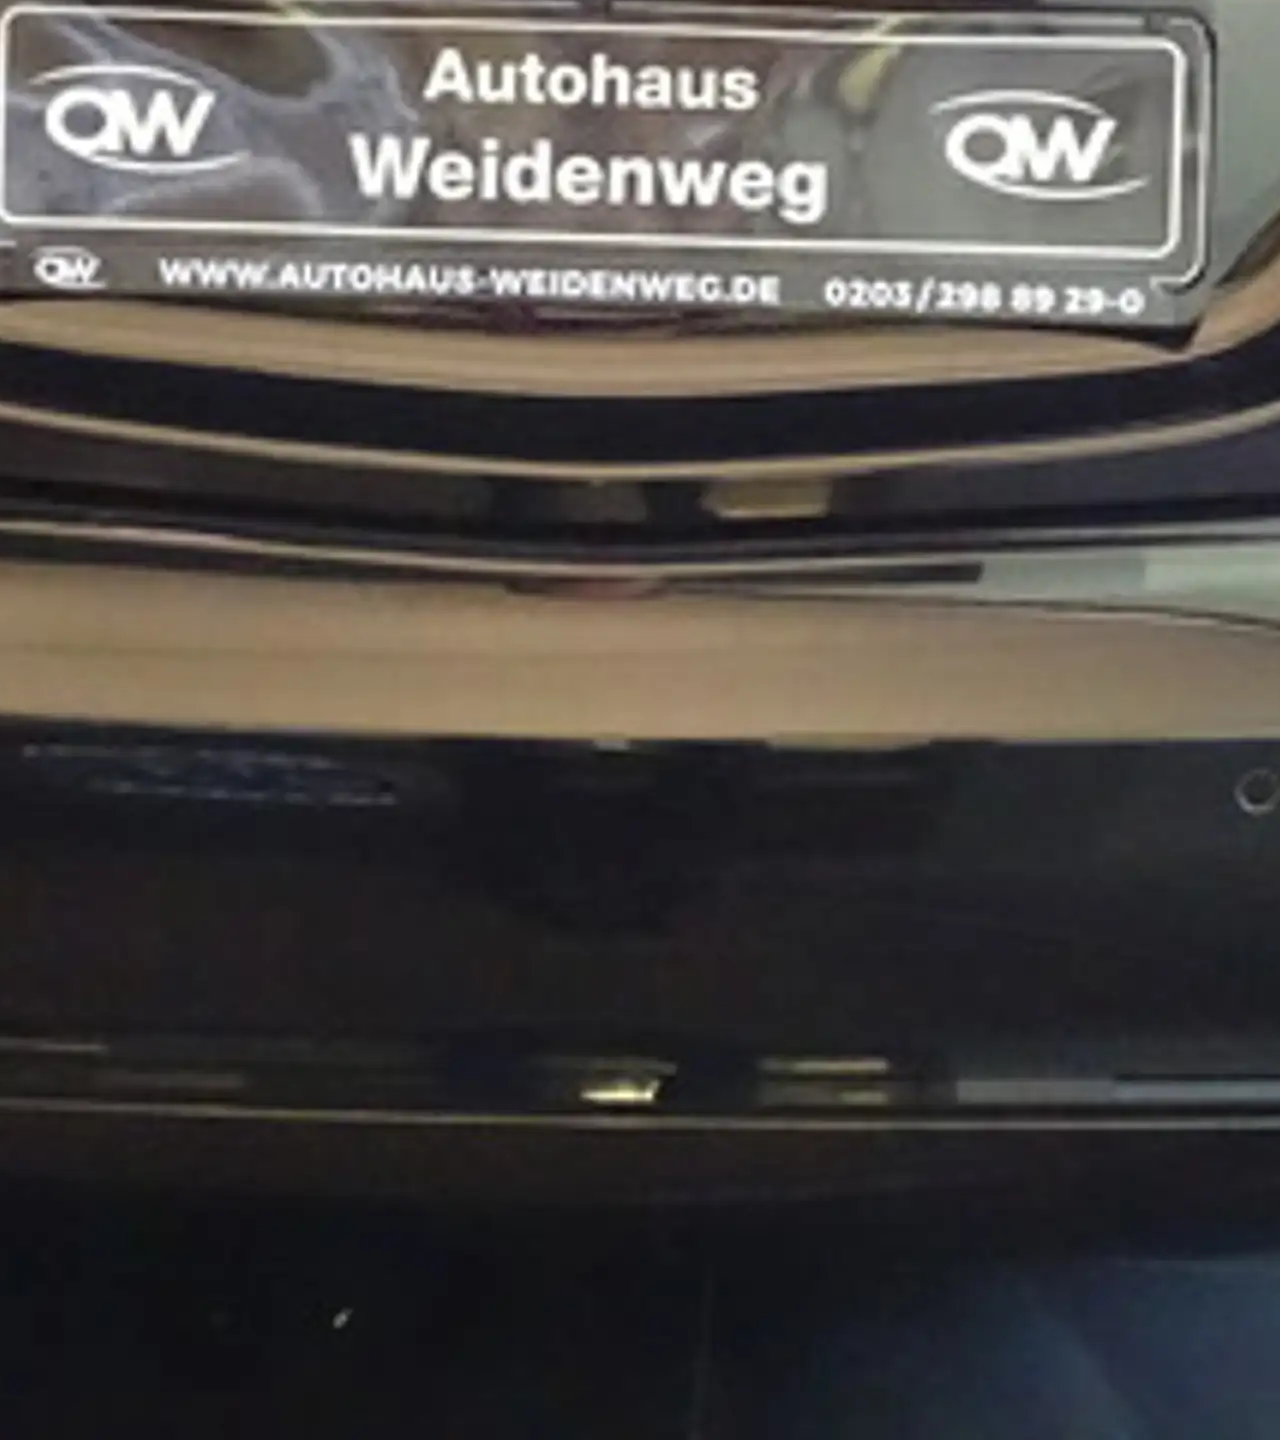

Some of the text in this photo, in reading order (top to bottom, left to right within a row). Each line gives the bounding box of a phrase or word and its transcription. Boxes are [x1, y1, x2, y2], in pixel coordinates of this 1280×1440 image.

[423, 47, 761, 111] Autohaus
[348, 133, 828, 225] Weidenweg
[159, 258, 782, 306] WWW.AUTOHAUS-WEIDENWEG.DE
